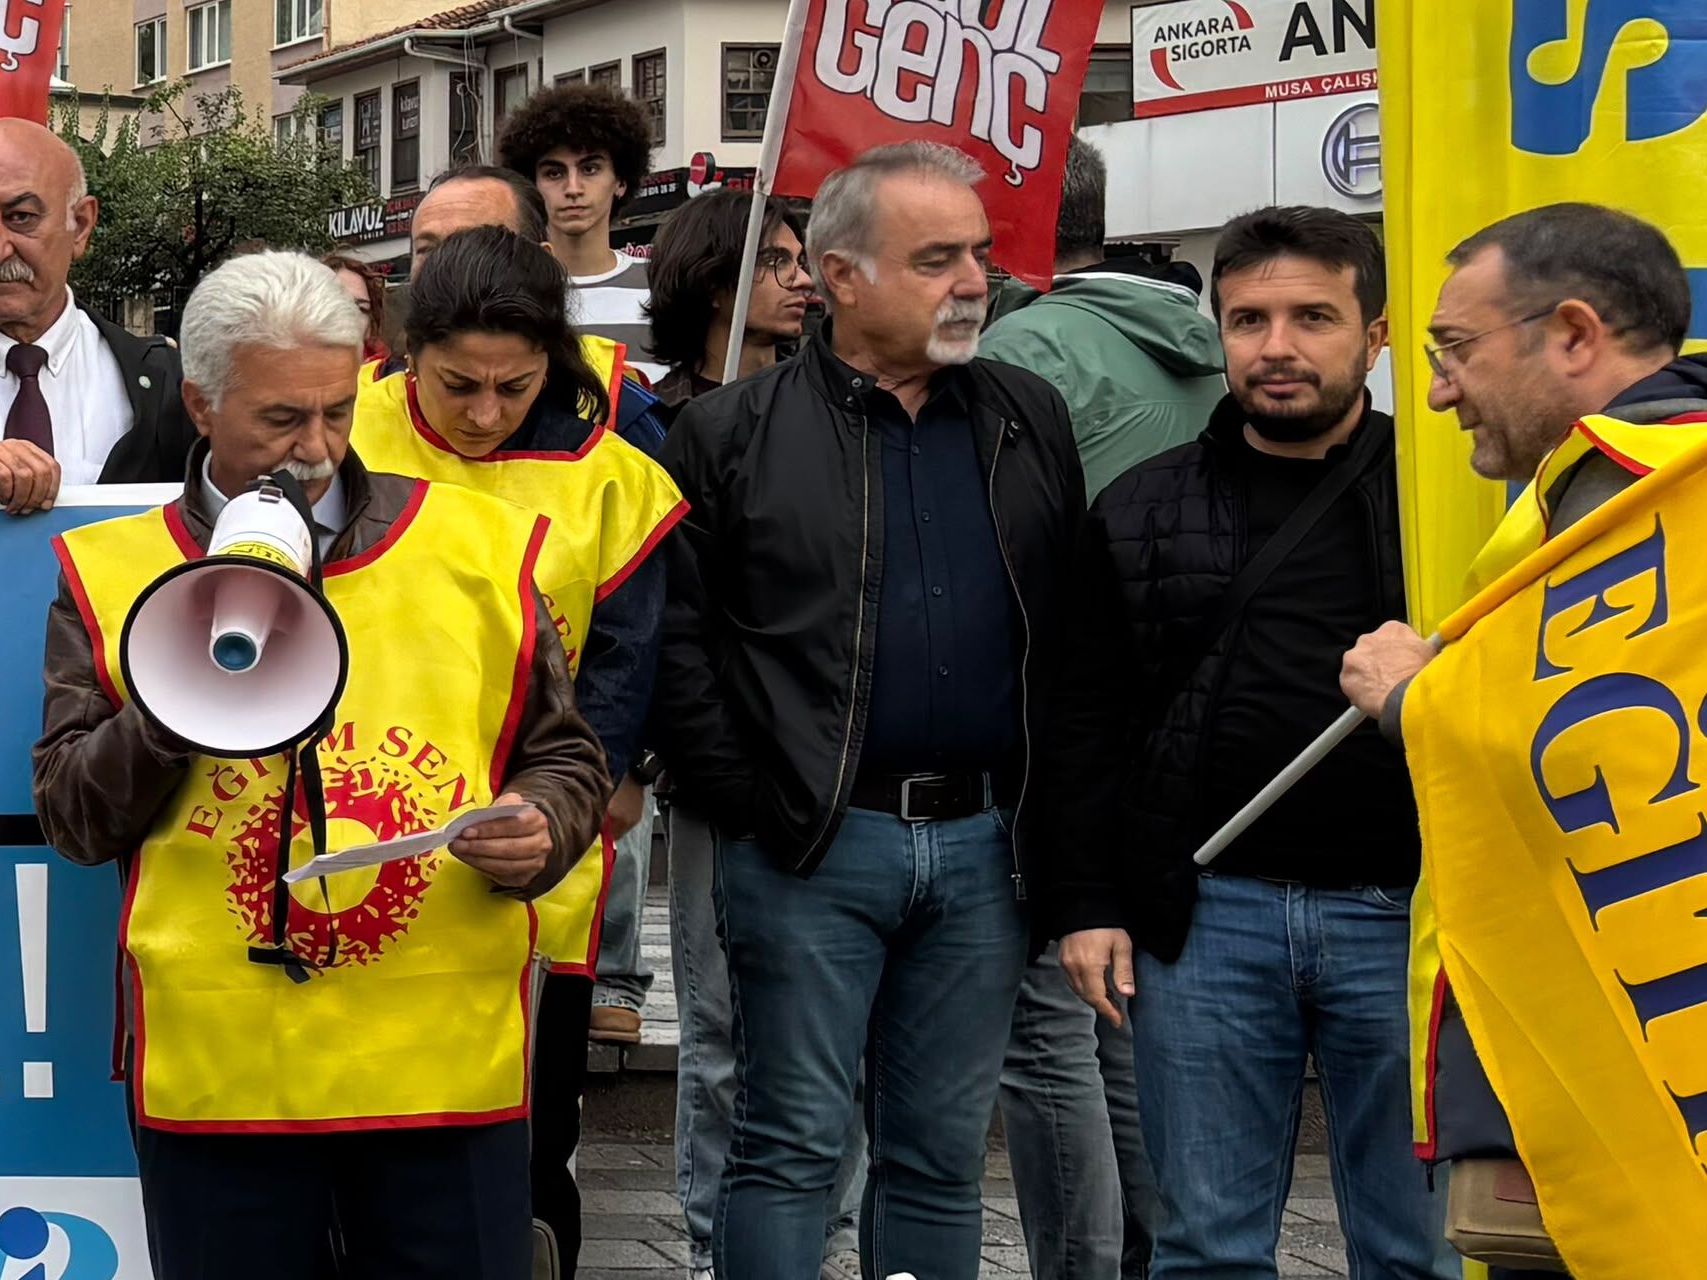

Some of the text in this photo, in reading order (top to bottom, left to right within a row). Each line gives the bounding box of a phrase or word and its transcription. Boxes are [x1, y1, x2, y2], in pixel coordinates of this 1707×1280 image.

[1153, 15, 1234, 44] ANKARA
[1265, 81, 1313, 99] MUSA
[328, 205, 385, 239] KILAVUZ
[379, 726, 475, 812] SEN
